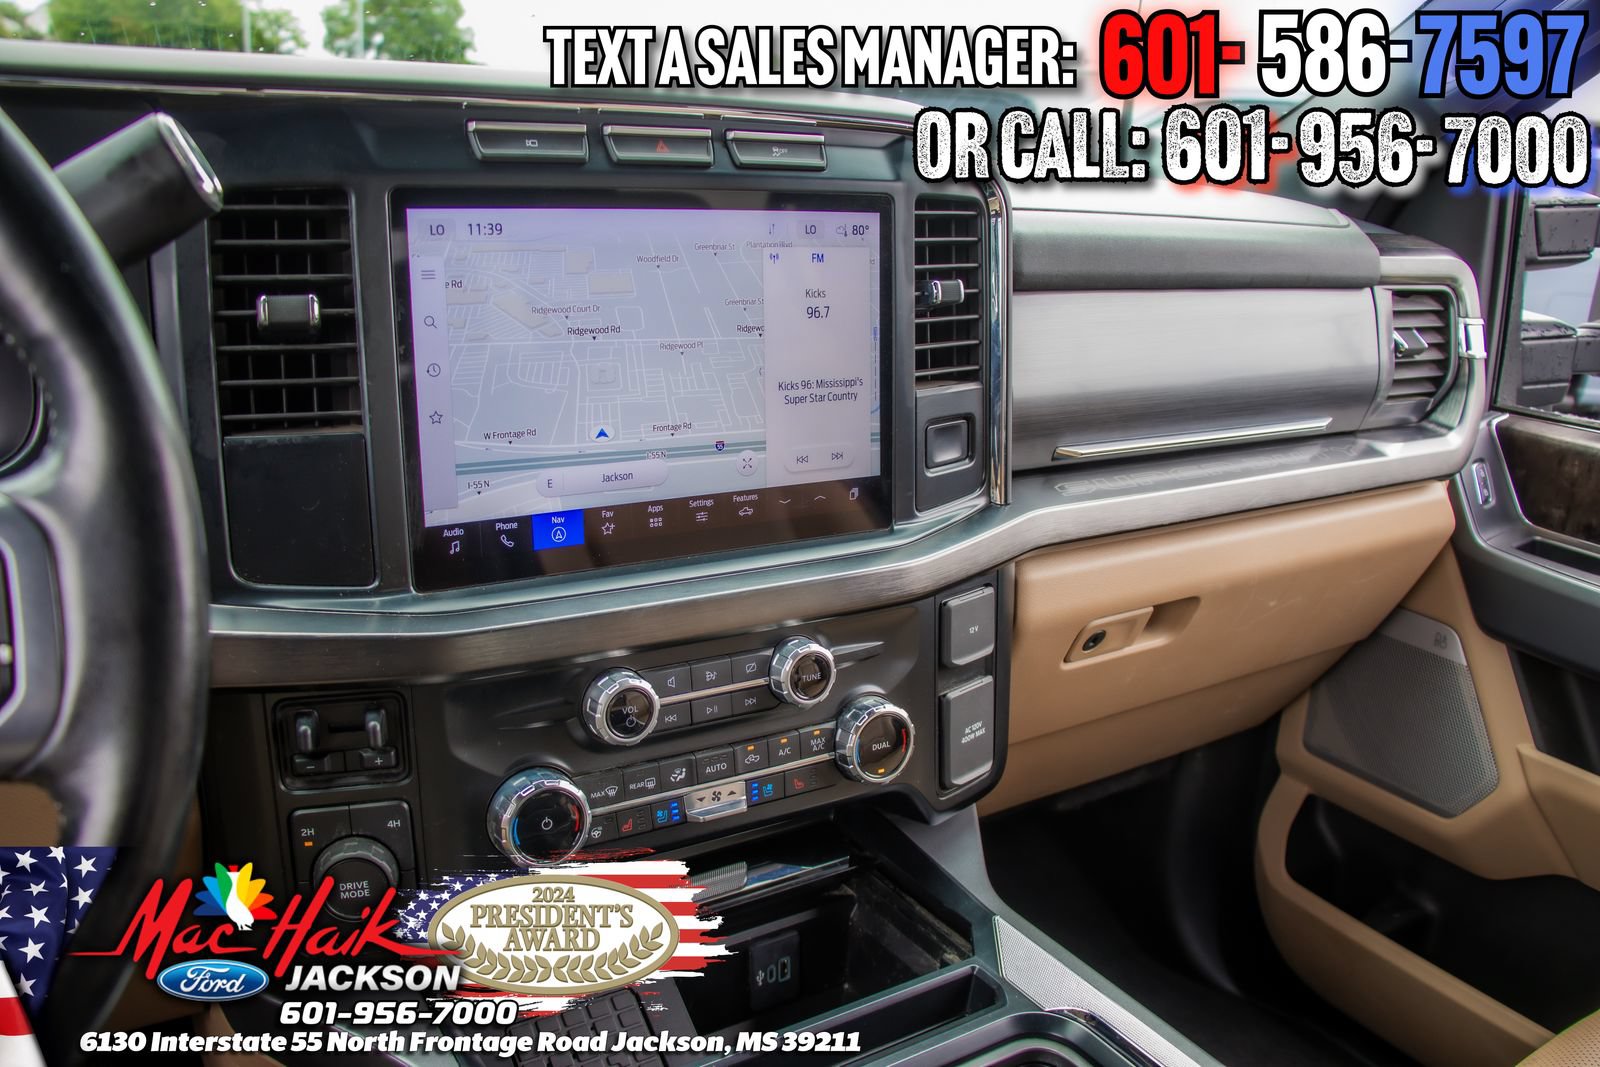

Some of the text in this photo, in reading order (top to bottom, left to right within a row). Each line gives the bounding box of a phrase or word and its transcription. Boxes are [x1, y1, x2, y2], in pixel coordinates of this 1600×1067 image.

[430, 224, 445, 236] LO
[467, 223, 503, 236] 11:39
[805, 224, 817, 235] LO
[852, 224, 870, 236] 80°
[727, 242, 735, 250] St
[636, 255, 679, 264] Woodfield Dr
[811, 253, 825, 263] FM
[451, 279, 463, 289] Rd
[805, 288, 826, 299] Kicks
[531, 306, 571, 316] Ridgewood
[572, 305, 590, 313] Court
[806, 306, 830, 319] 96.7
[567, 325, 621, 337] Ridgewood Rd
[659, 342, 696, 352] Ridgewood
[778, 376, 864, 391] Kicks 96: Mississippi's
[784, 390, 859, 405] Super Star Country
[652, 422, 692, 433] Frontage Rd
[483, 428, 537, 441] W Frontage Rd
[601, 471, 634, 483] Jackson
[467, 480, 490, 489] I-55 N
[547, 478, 553, 489] E
[689, 497, 714, 508] Settings
[733, 493, 758, 503] Features
[647, 504, 664, 513] Apps
[551, 516, 565, 524] Nav
[601, 510, 614, 519] Fav
[495, 521, 518, 531] Phone
[443, 528, 465, 537] Audio
[801, 671, 822, 682] TUNE
[622, 704, 639, 714] VOL
[964, 725, 972, 735] AC
[975, 727, 986, 739] MAX
[811, 736, 826, 747] MAX
[872, 740, 891, 751] DUAL
[778, 746, 791, 757] A/C
[812, 743, 825, 752] A/C
[706, 762, 727, 774] AUTO
[629, 781, 645, 791] REAR
[590, 790, 605, 799] MAX
[387, 819, 400, 828] 4H
[301, 827, 314, 837] 2H
[339, 880, 369, 892] DRIVE
[340, 888, 371, 900] MODE
